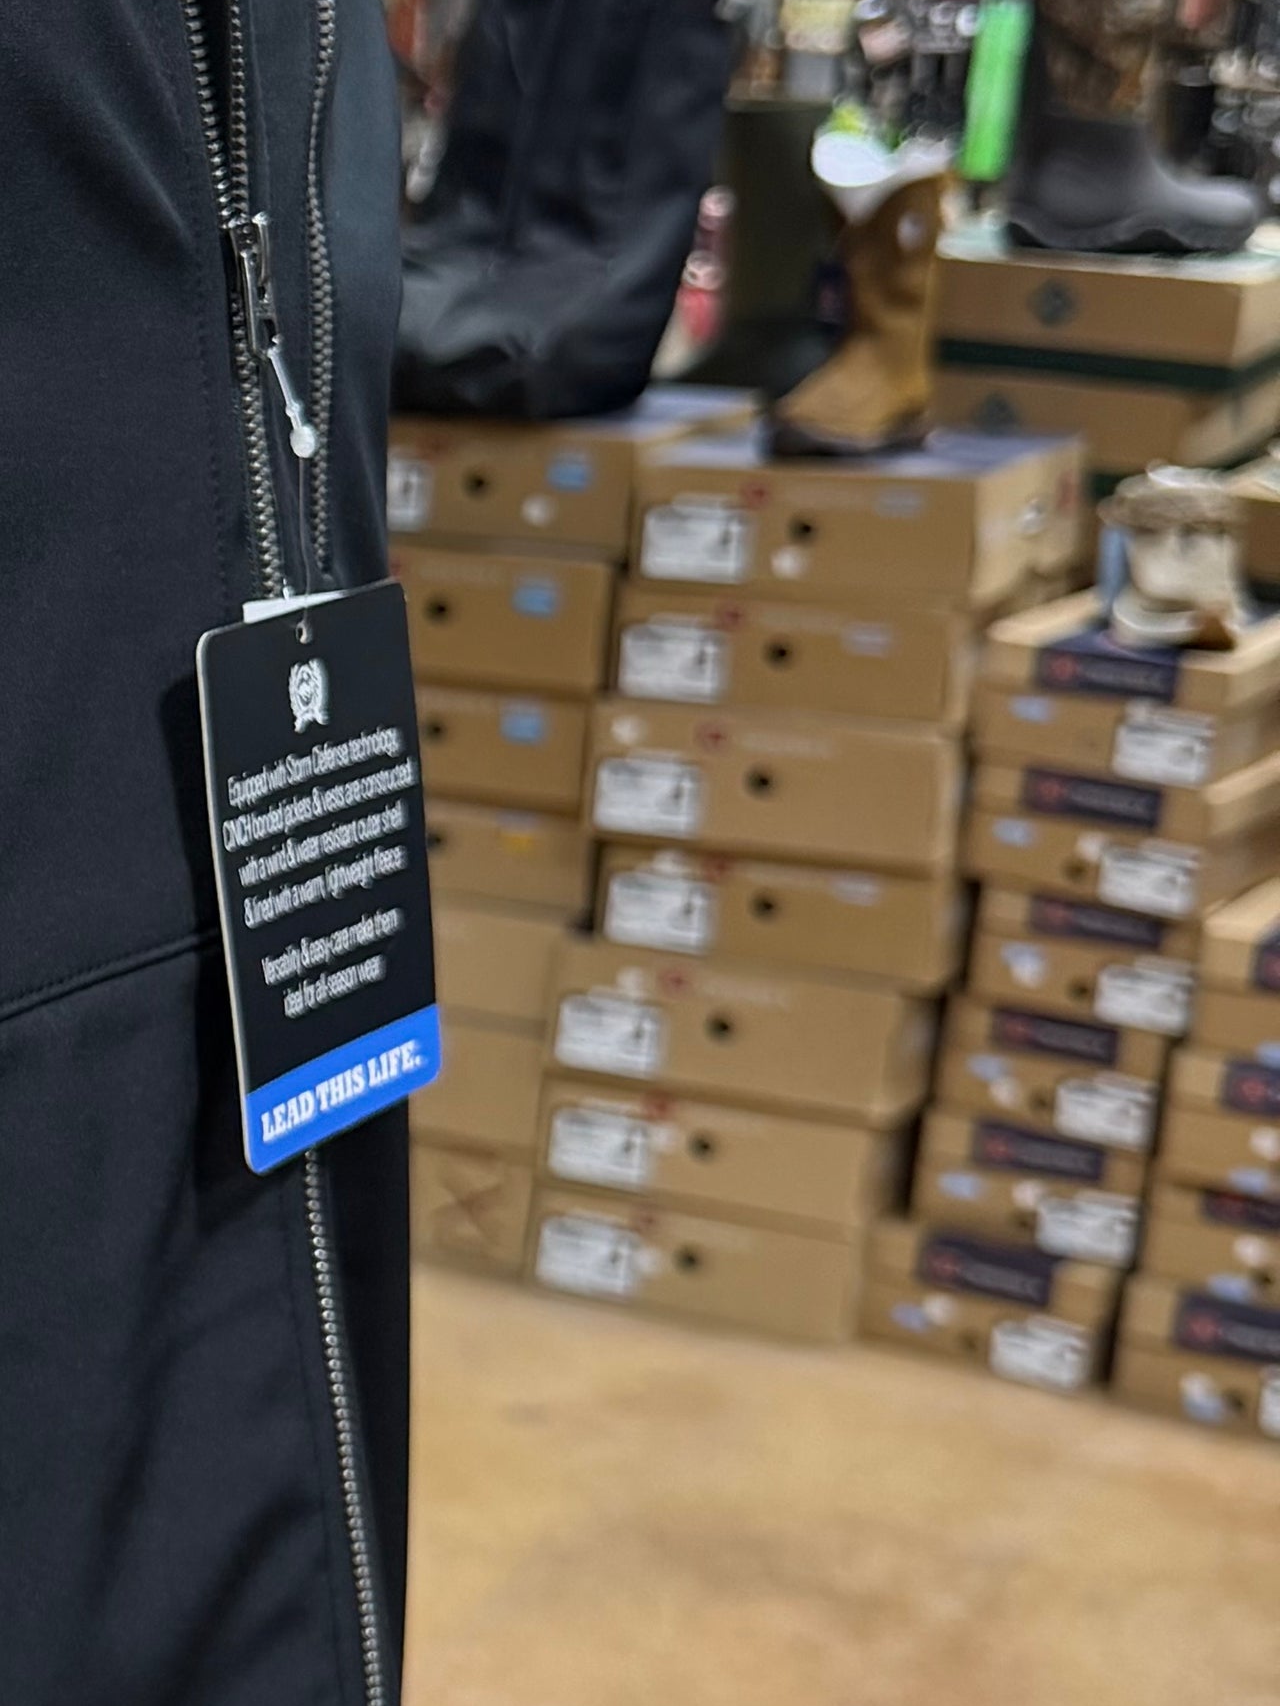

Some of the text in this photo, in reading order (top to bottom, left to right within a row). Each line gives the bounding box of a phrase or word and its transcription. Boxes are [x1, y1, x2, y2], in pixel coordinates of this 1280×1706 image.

[227, 765, 268, 809] Equipped
[268, 759, 288, 793] with
[286, 753, 313, 786] Storm
[312, 741, 349, 777] Defense
[251, 804, 284, 841] bonded
[283, 795, 313, 835] jackets
[322, 785, 346, 815] vests
[360, 756, 417, 801] constructed
[238, 855, 260, 887] with
[266, 843, 289, 877] wind
[296, 835, 321, 865] water
[319, 821, 358, 858] resistant
[356, 813, 382, 841] outer
[381, 798, 408, 834] shell
[253, 891, 275, 925] lined
[273, 885, 292, 918] with
[349, 914, 375, 949] make
[373, 908, 404, 937] them
[283, 982, 305, 1019] ideal
[261, 1039, 423, 1143] LEAD THIS LIFE.
